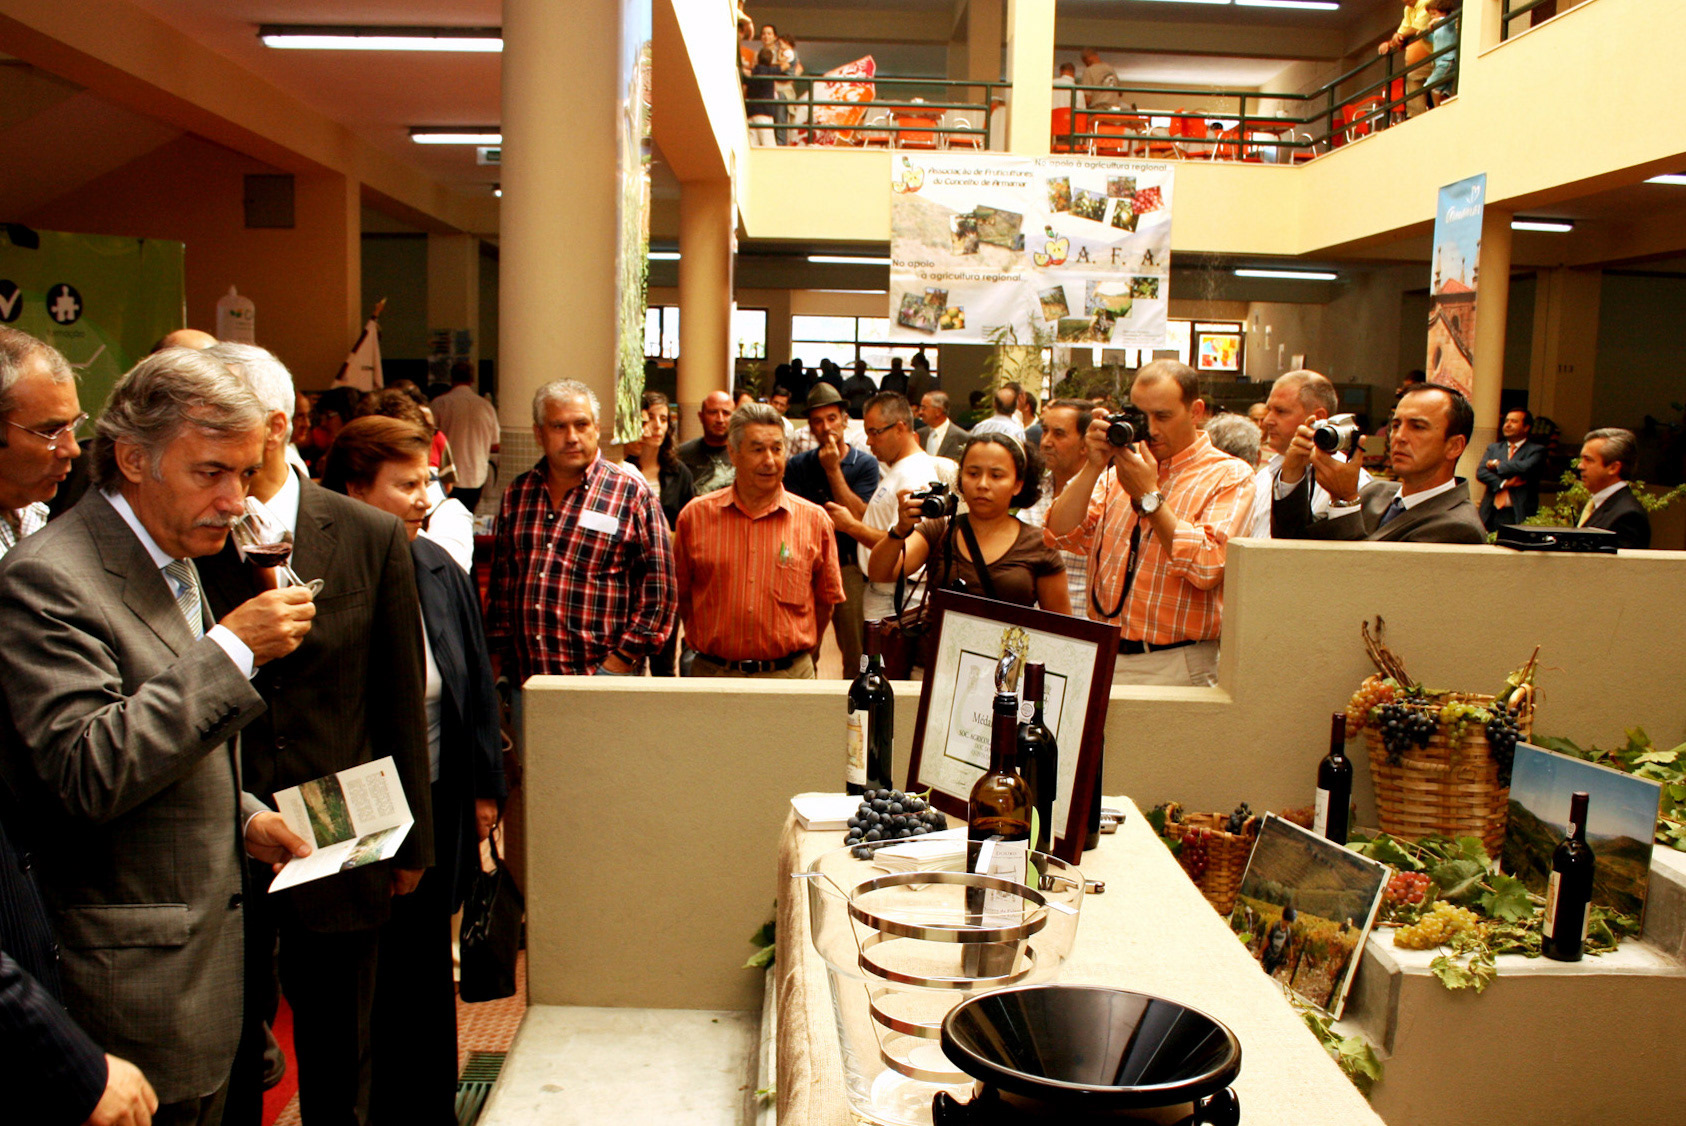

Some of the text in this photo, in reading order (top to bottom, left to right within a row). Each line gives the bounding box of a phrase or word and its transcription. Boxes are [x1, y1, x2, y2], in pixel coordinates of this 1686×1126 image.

[1035, 159, 1046, 167] No
[1049, 160, 1075, 169] apoio
[1084, 161, 1130, 171] agricultura
[1131, 163, 1167, 172] regional
[928, 166, 1034, 178] Associação de Fruticultores
[933, 178, 1027, 189] do Concelho de Armamar
[892, 259, 935, 269] No apoio
[930, 272, 980, 282] agricultura
